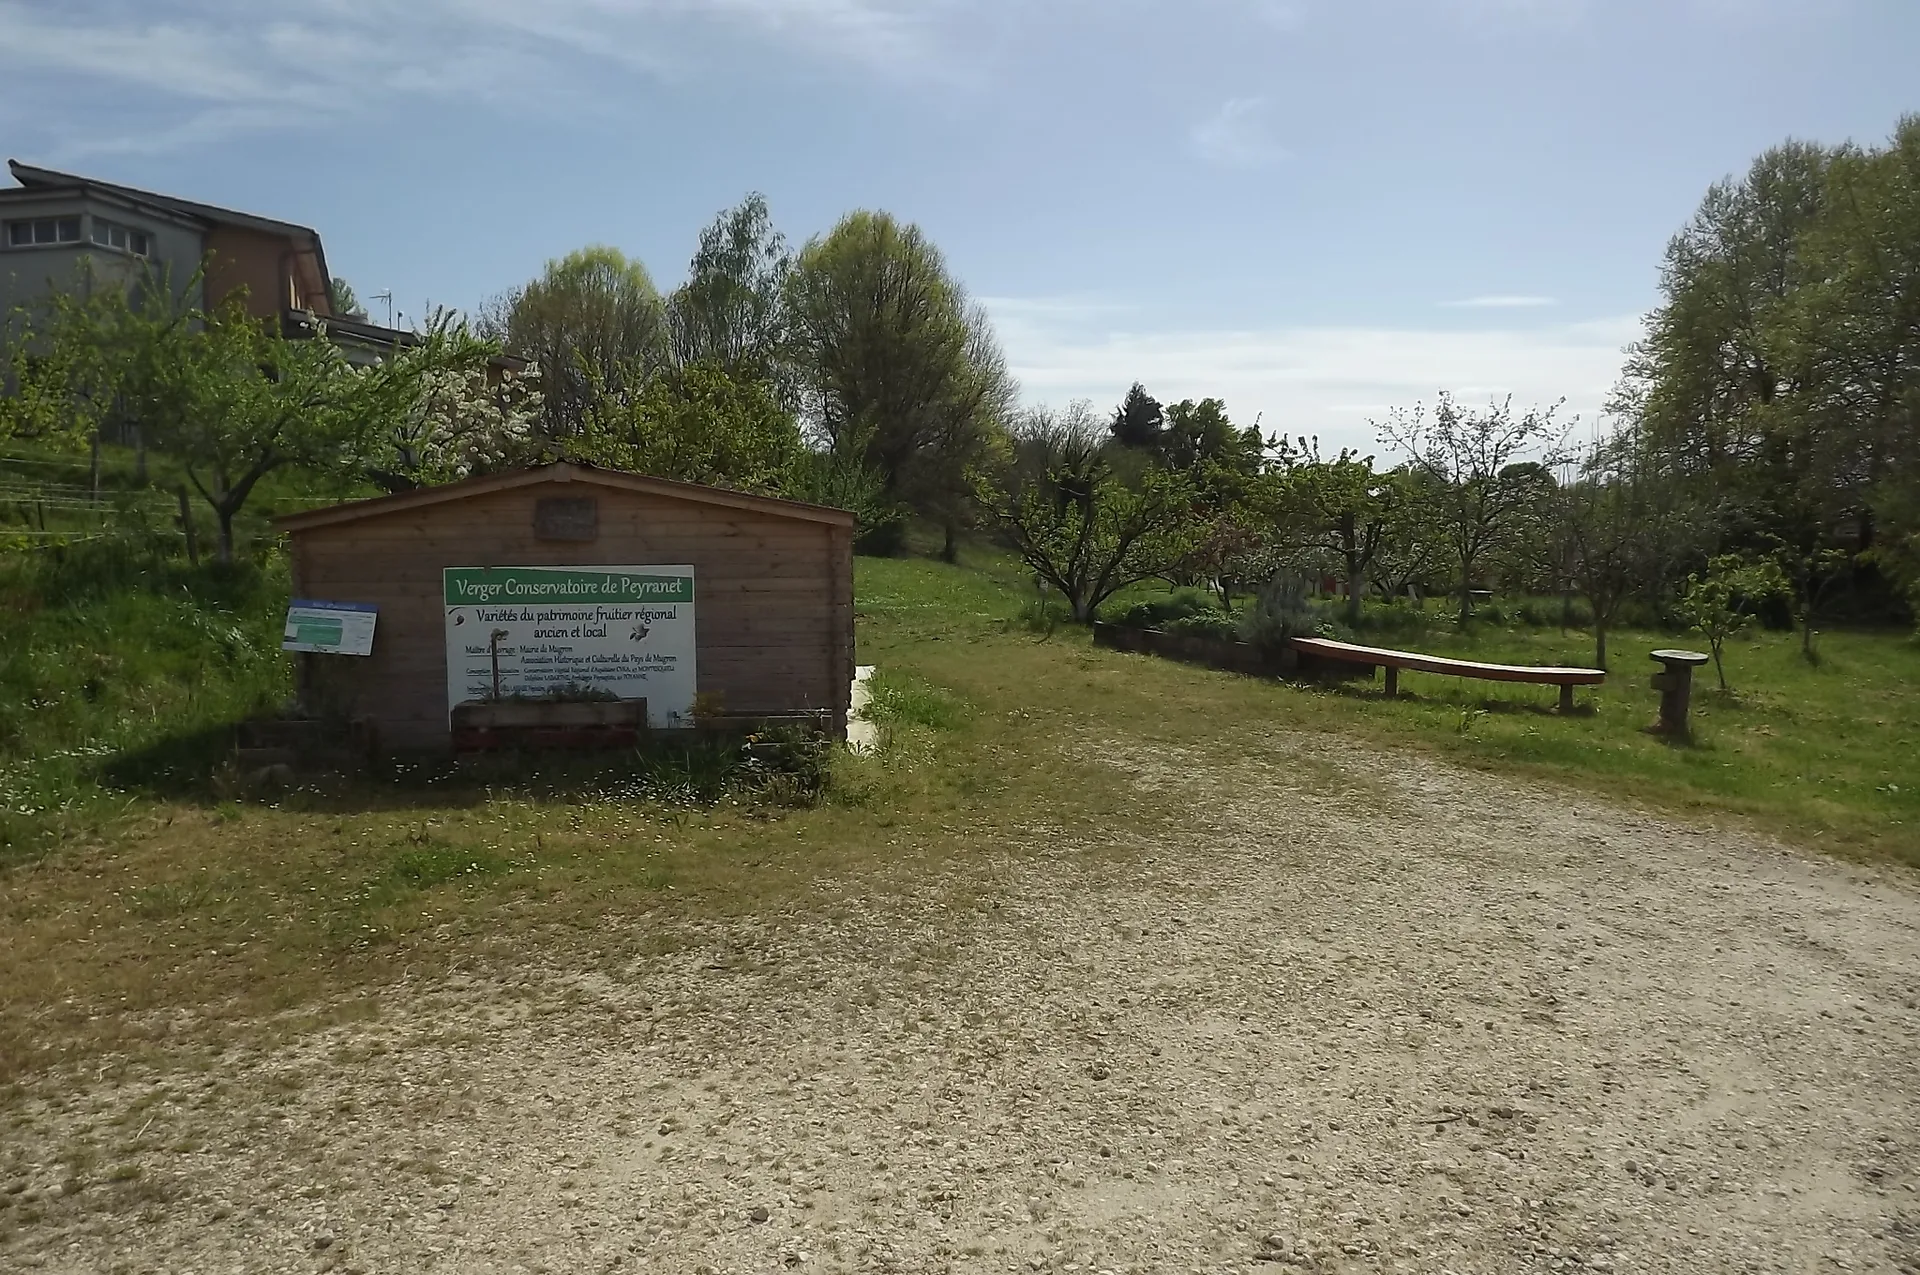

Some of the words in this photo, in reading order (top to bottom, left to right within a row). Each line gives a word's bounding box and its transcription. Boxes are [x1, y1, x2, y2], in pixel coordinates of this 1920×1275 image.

[456, 579, 502, 601] Verger
[505, 578, 598, 595] Conservatoire
[601, 575, 618, 593] de
[621, 577, 682, 599] Peyranet
[476, 606, 518, 622] Variétés
[520, 607, 534, 621] du
[536, 608, 593, 625] patrimoine
[593, 604, 633, 625] fruitier
[634, 605, 677, 624] régional
[534, 626, 568, 638] ancien
[571, 625, 581, 638] et
[583, 623, 607, 638] local
[540, 644, 547, 653] de
